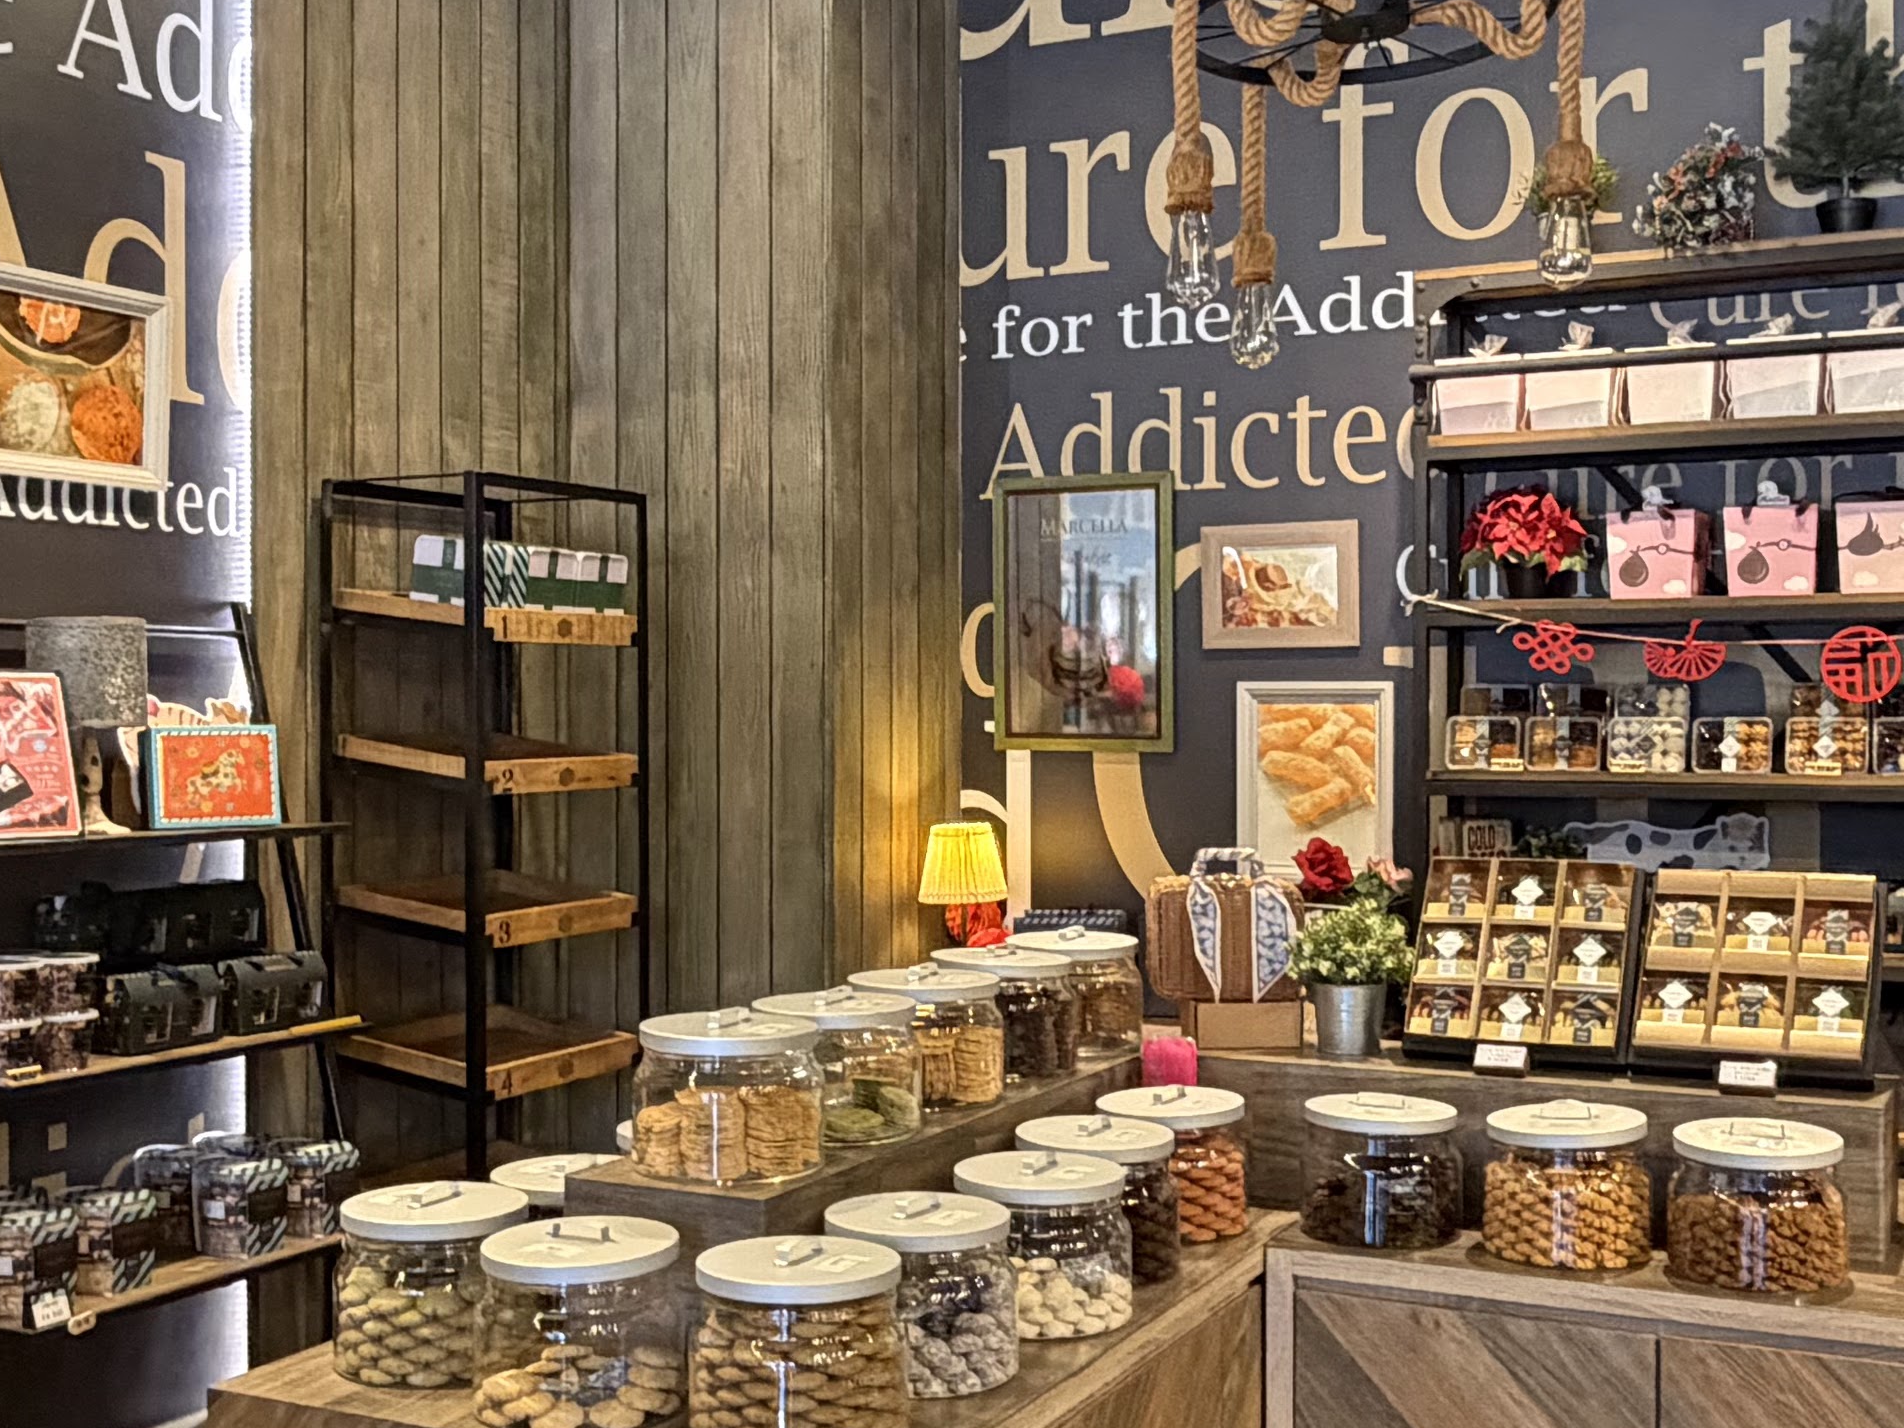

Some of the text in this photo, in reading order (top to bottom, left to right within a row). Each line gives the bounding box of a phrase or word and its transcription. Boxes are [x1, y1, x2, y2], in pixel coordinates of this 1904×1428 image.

[1320, 38, 1648, 251] for
[991, 305, 1093, 359] for
[1118, 293, 1232, 349] the
[1040, 518, 1128, 535] MARCELLA
[502, 768, 514, 793] 2
[498, 920, 511, 943] 3
[501, 1072, 514, 1097] 4
